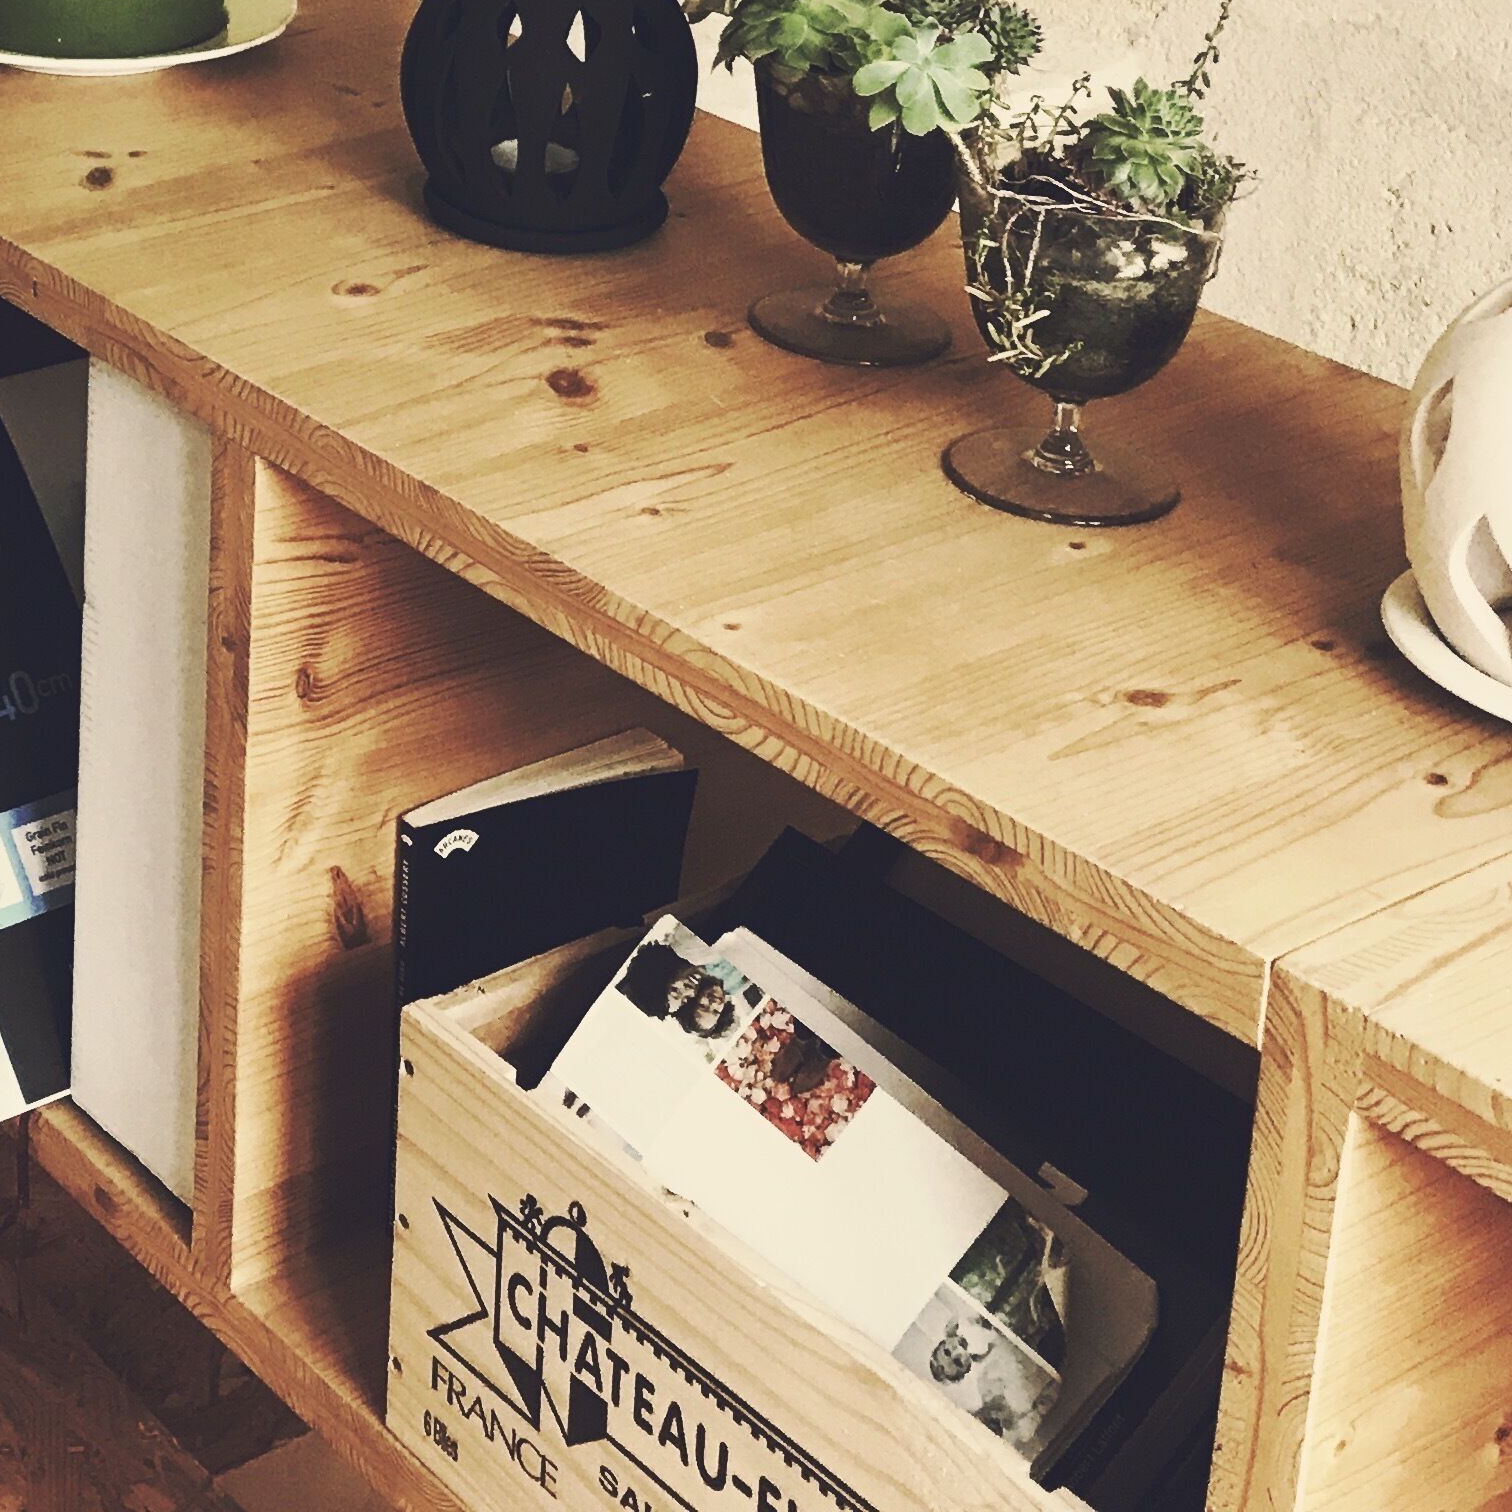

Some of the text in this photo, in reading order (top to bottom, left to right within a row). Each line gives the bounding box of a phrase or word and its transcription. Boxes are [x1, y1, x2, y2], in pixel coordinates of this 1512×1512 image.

[424, 1409, 432, 1436] 6
[431, 1356, 558, 1499] FRANCE
[507, 1273, 797, 1512] CHATEAU-F
